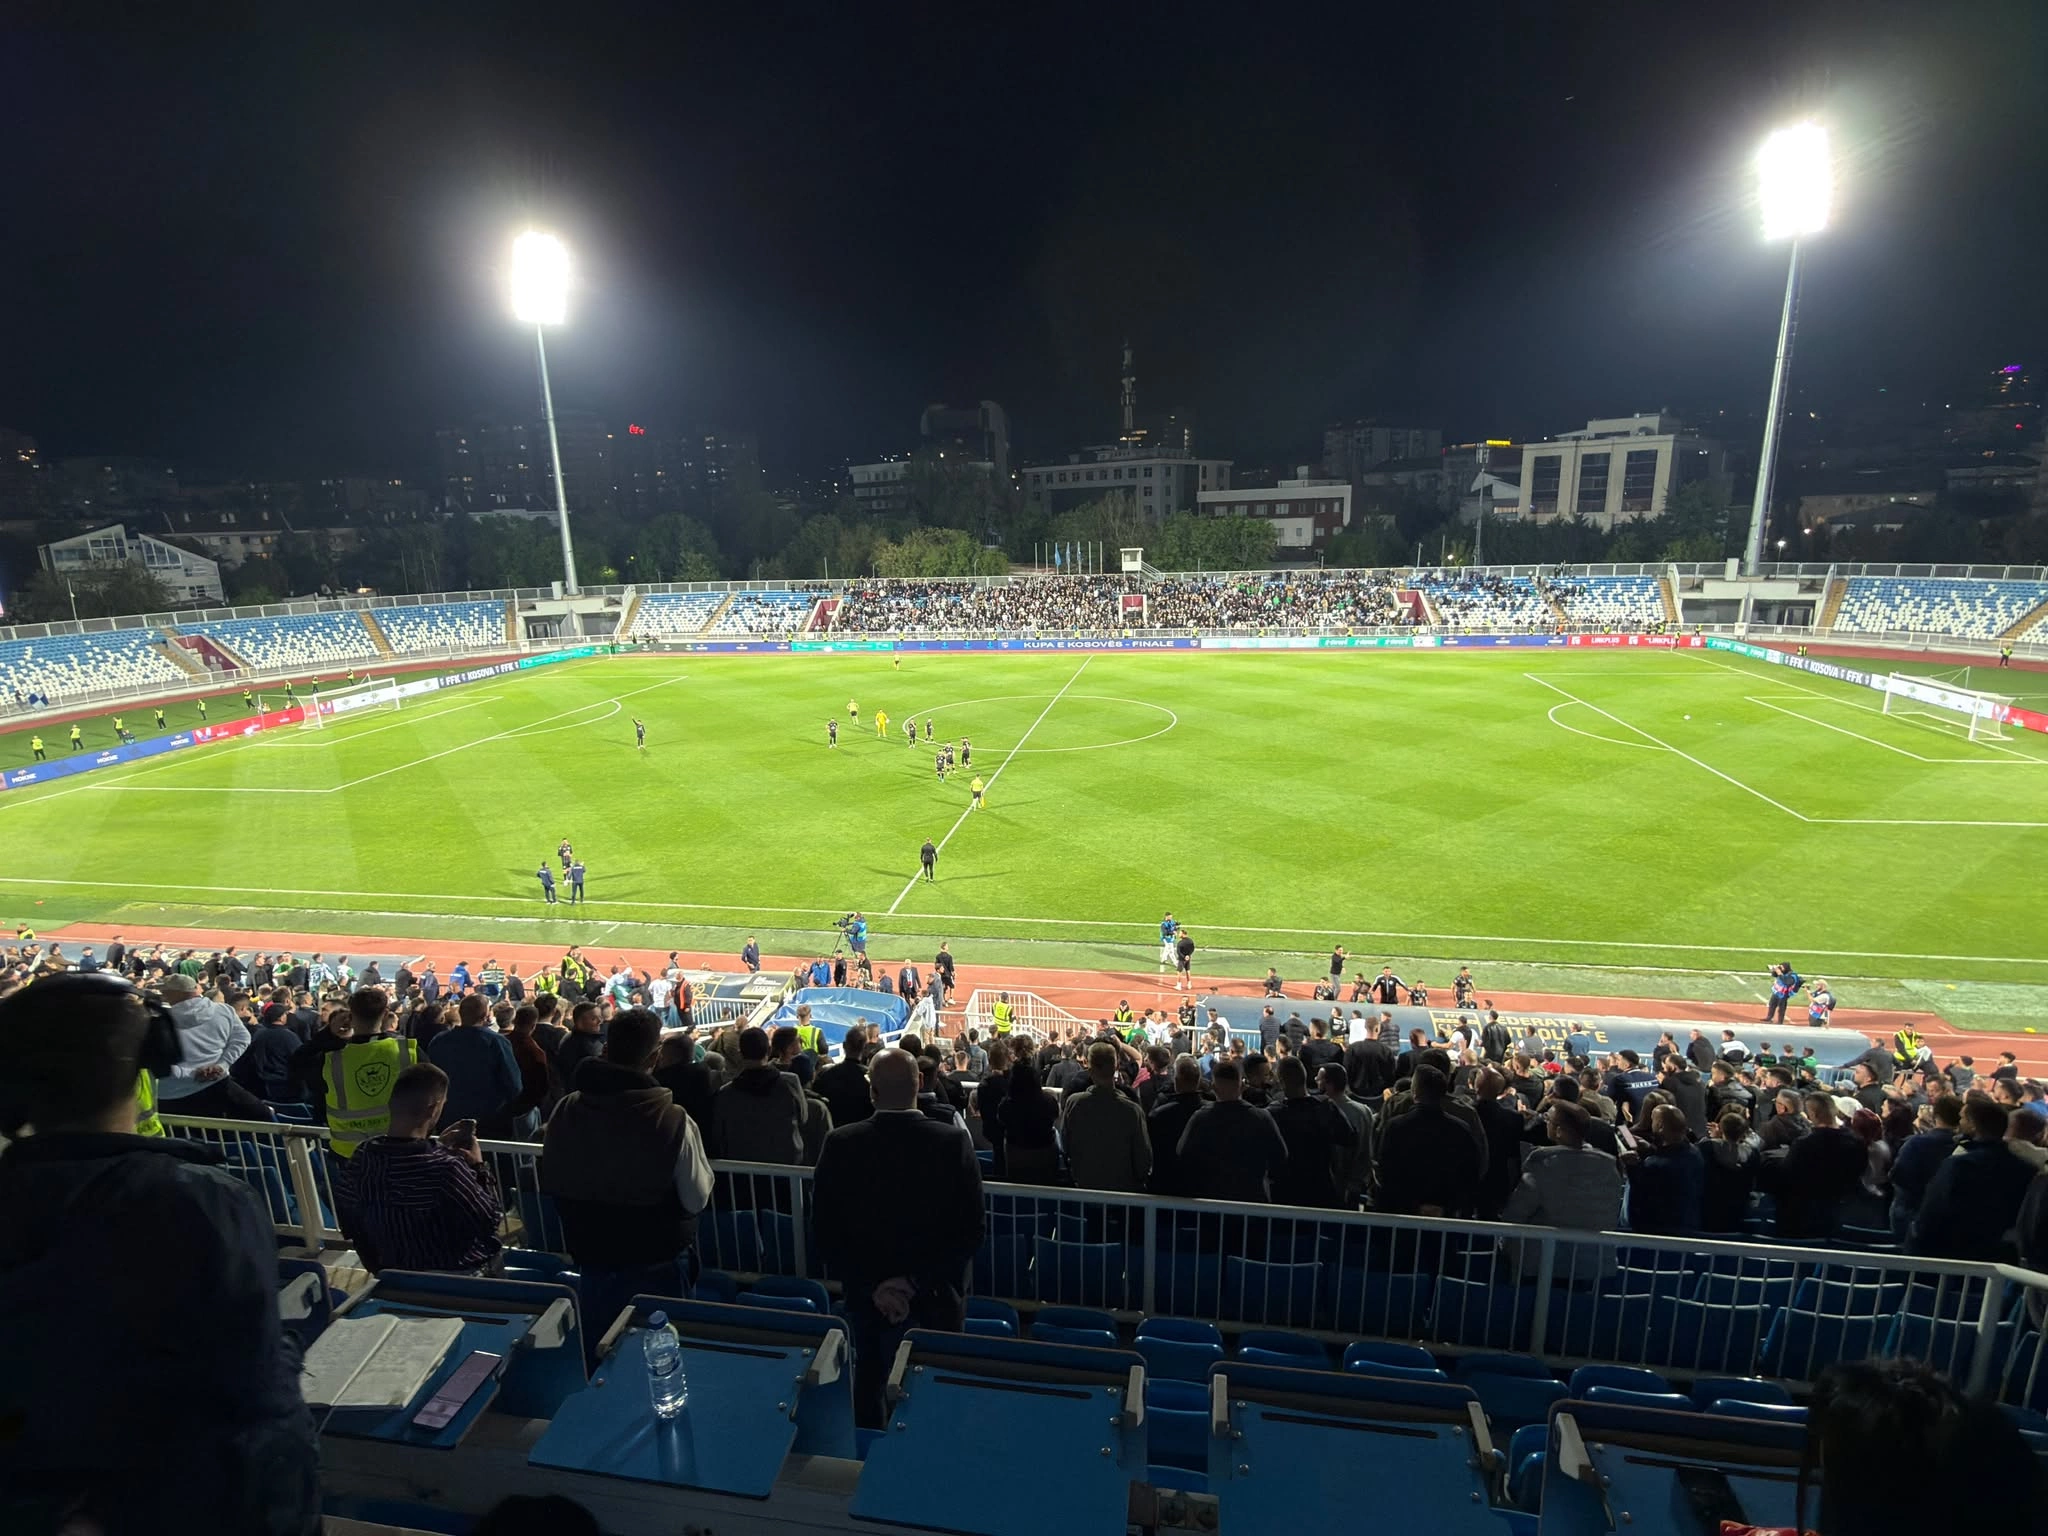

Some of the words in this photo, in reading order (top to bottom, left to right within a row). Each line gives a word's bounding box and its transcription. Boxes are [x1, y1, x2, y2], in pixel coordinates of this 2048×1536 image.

[1023, 641, 1055, 649] KUPA
[1067, 640, 1123, 648] KOSOVËS
[445, 674, 461, 686] FFK
[467, 666, 495, 680] KOSOVA
[500, 662, 515, 673] FFK
[1789, 656, 1803, 669] FFK
[1810, 661, 1839, 678] KOSOVA
[1846, 670, 1862, 684] FFK
[1583, 1019, 1597, 1029] E
